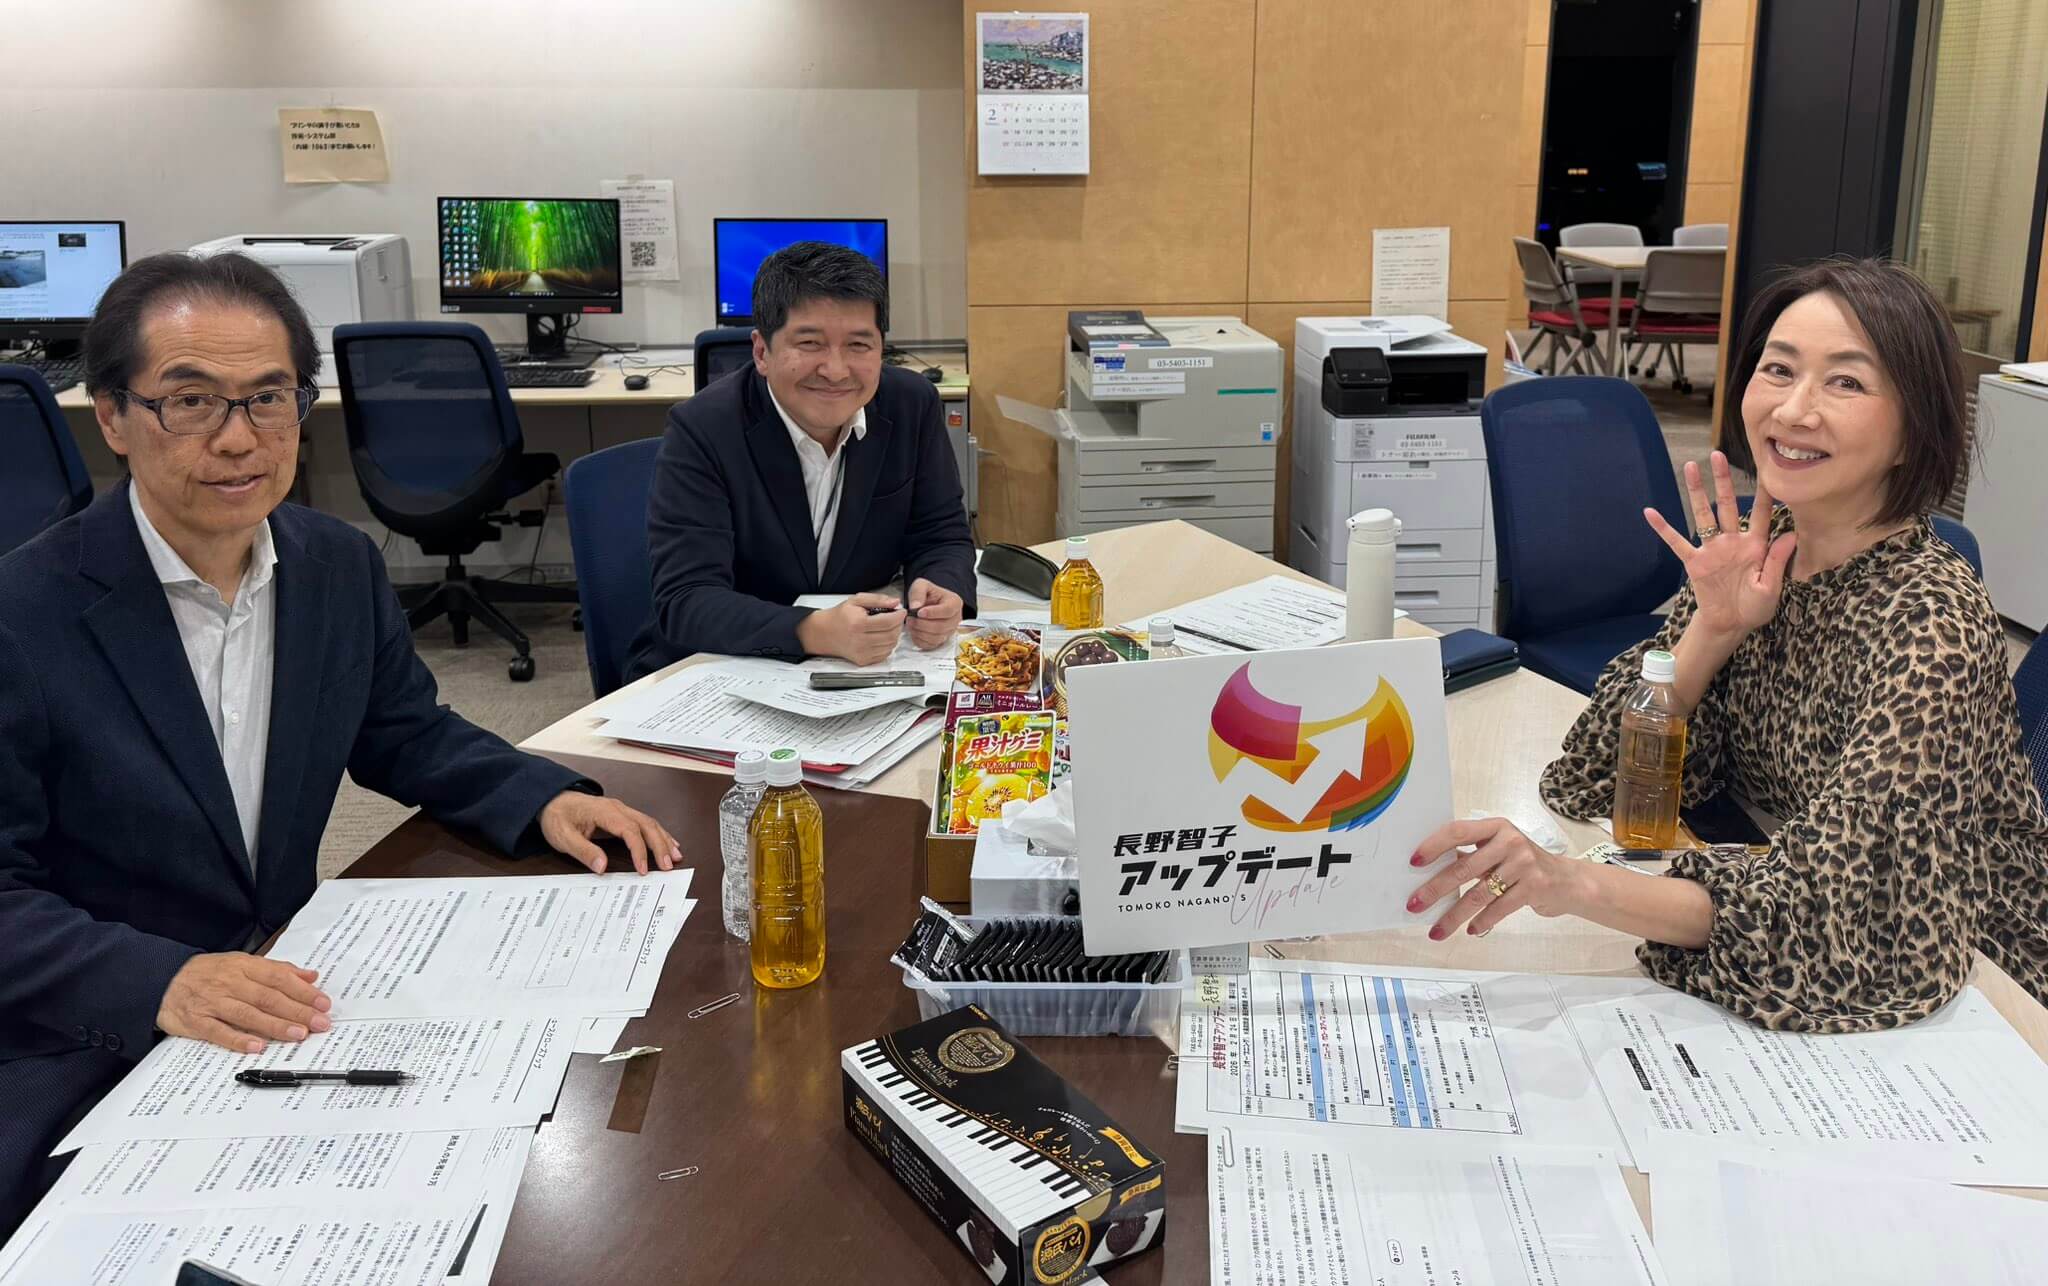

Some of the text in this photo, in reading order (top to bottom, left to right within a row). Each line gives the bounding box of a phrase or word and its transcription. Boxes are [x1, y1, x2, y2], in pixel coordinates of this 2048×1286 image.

[987, 108, 997, 121] 2
[1156, 359, 1206, 368] 03-5403-1151
[964, 729, 1044, 764] 果汁グミ
[1113, 825, 1237, 857] 長野智子
[1118, 843, 1352, 896] アップデート
[1118, 893, 1248, 913] TOMOKO NAGANO'S
[1229, 862, 1346, 930] Update
[1230, 1060, 1239, 1076] 2026
[1040, 1231, 1083, 1264] 源氏パイ
